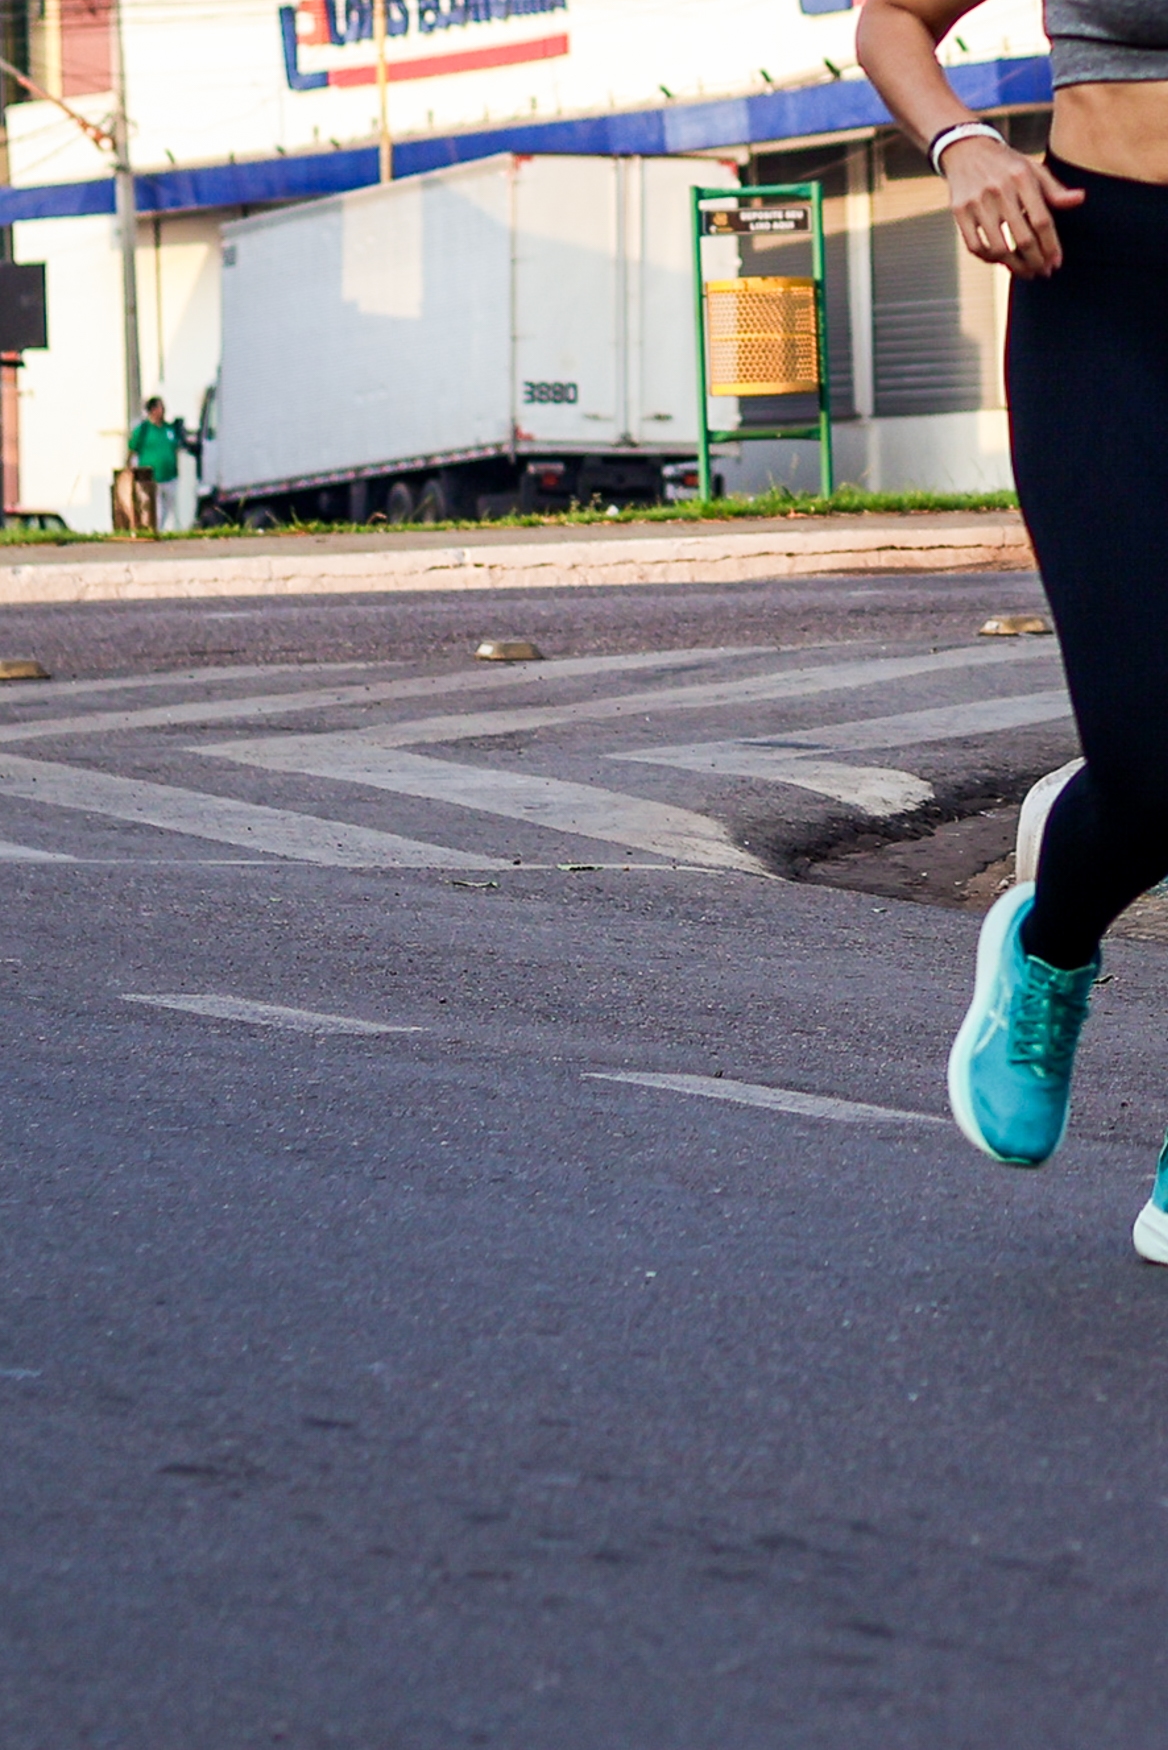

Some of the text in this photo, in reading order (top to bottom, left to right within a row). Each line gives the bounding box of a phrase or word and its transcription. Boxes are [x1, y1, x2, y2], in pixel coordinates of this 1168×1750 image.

[740, 209, 804, 222] DEPOSITE SEU
[749, 220, 796, 231] LIXO AQUI
[523, 381, 578, 405] 3880
